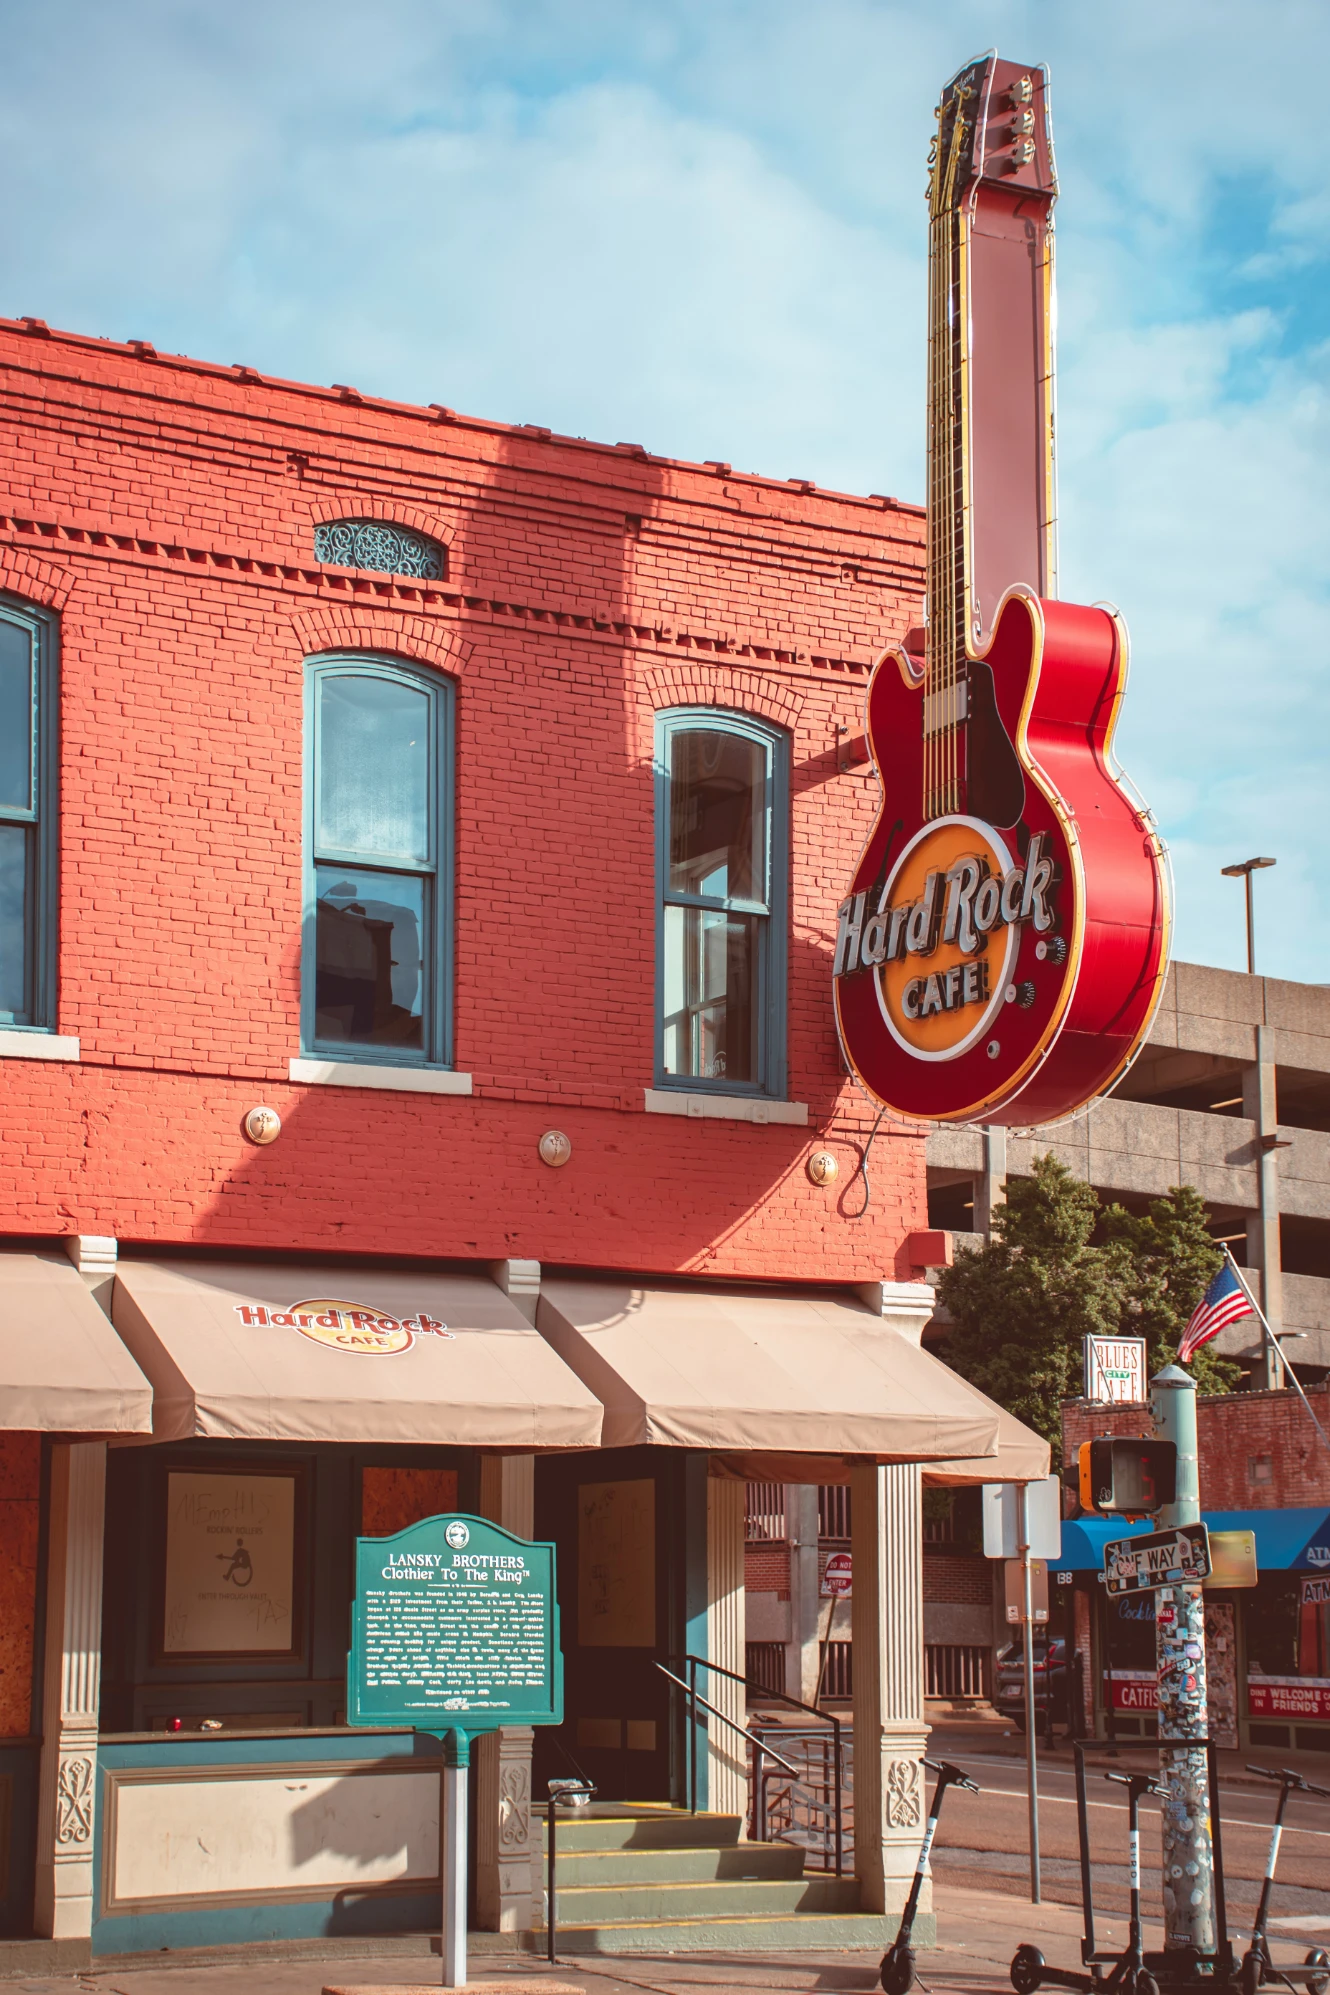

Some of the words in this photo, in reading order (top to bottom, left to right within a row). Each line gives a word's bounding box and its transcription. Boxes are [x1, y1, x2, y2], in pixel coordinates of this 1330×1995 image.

[833, 871, 942, 978] Hard
[943, 836, 1054, 953] Rock
[902, 961, 981, 1019] CAFE
[235, 1306, 342, 1328] Hard
[345, 1310, 454, 1338] Rock
[336, 1335, 388, 1346] CAFE
[1096, 1345, 1138, 1369] BLUES
[1097, 1371, 1137, 1401] CAFE
[206, 1525, 235, 1535] ROCKIN'
[235, 1526, 264, 1536] ROLLERS
[389, 1554, 443, 1567] LANSKY
[452, 1555, 525, 1569] BROTHERS
[1147, 1546, 1176, 1571] WAY
[382, 1567, 435, 1580] Clothier
[441, 1568, 458, 1581] To
[464, 1569, 489, 1581] The
[1057, 1572, 1073, 1584] 138
[829, 1579, 847, 1587] ENTER
[1250, 1689, 1266, 1697] DINE
[1270, 1688, 1321, 1701] WELCOME
[1255, 1699, 1264, 1707] IN
[1272, 1699, 1319, 1713] FRIENDS
[919, 1828, 934, 1863] BIRD
